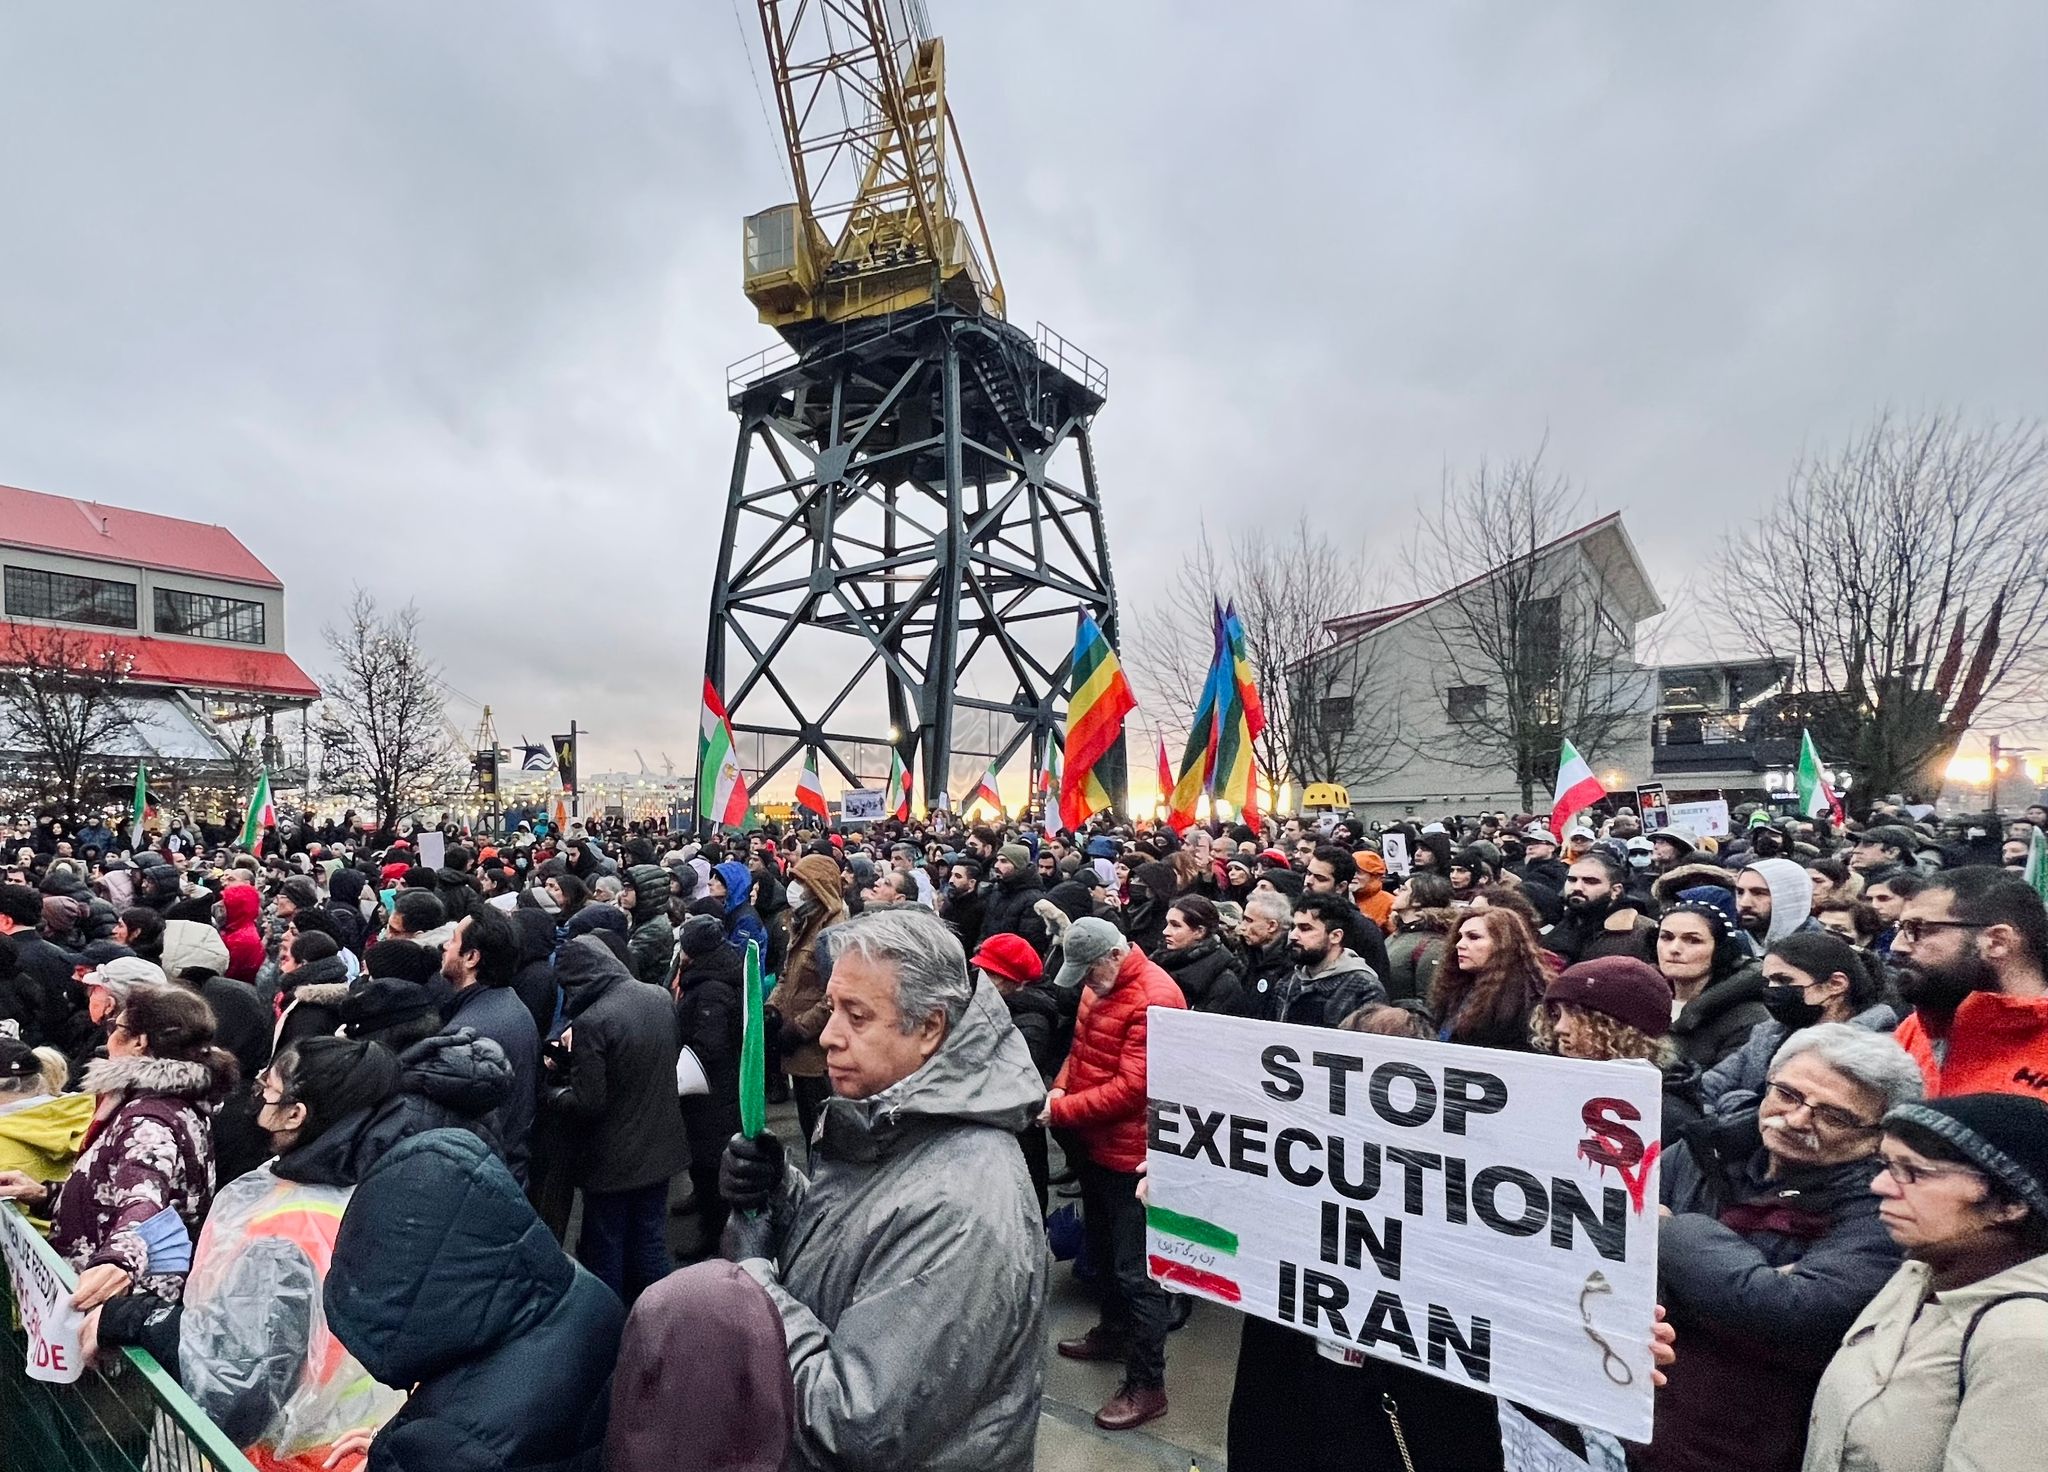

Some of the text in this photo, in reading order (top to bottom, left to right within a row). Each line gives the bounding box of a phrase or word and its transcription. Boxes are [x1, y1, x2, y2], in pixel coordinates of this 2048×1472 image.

[1671, 807, 1710, 816] LIBERTY
[1260, 1044, 1508, 1136] STOP
[1148, 1099, 1627, 1263] EXECUTION
[1320, 1201, 1402, 1281] IN
[1278, 1260, 1491, 1384] IRAN
